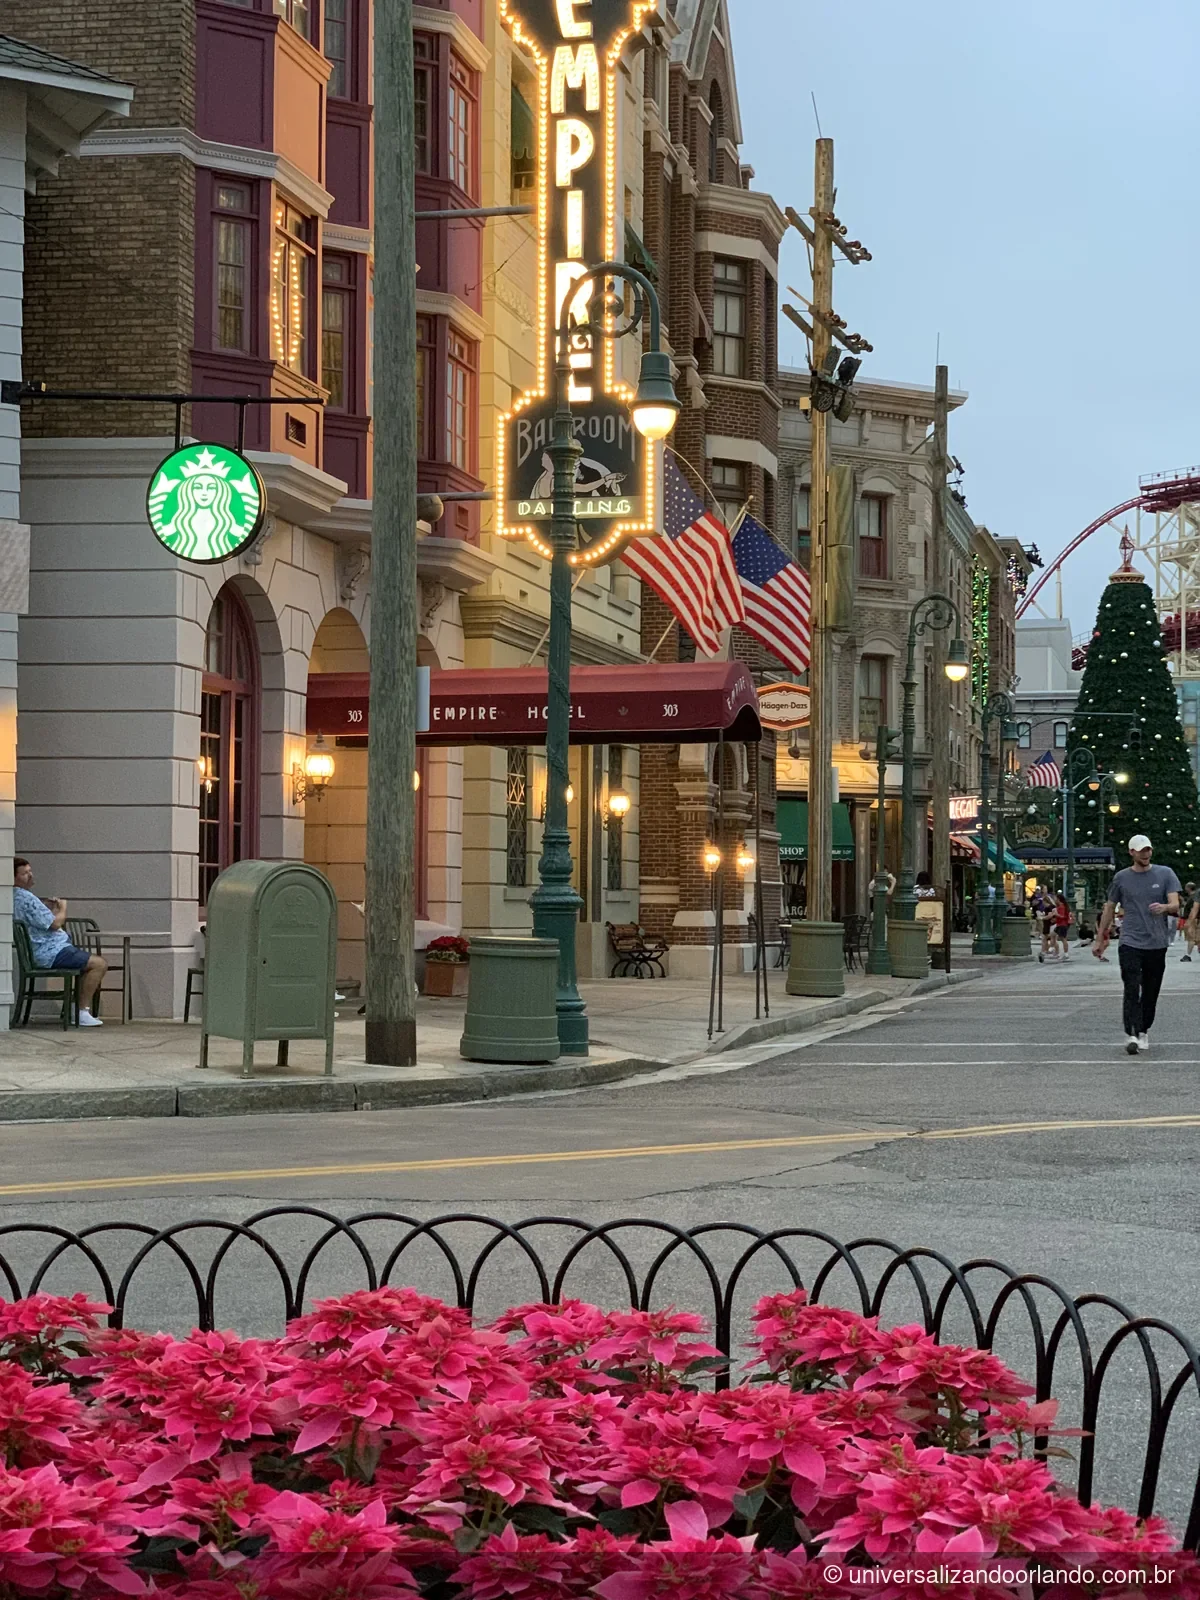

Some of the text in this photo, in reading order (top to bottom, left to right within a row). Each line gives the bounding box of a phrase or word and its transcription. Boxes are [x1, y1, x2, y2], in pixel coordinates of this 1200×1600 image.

[517, 415, 636, 468] BALROOM
[518, 499, 632, 516] DACING
[432, 705, 586, 721] EMPIRE HOEL
[662, 704, 679, 718] 303
[761, 701, 808, 711] Häagen-Dazs
[347, 710, 363, 724] 303
[779, 847, 805, 856] SHOP
